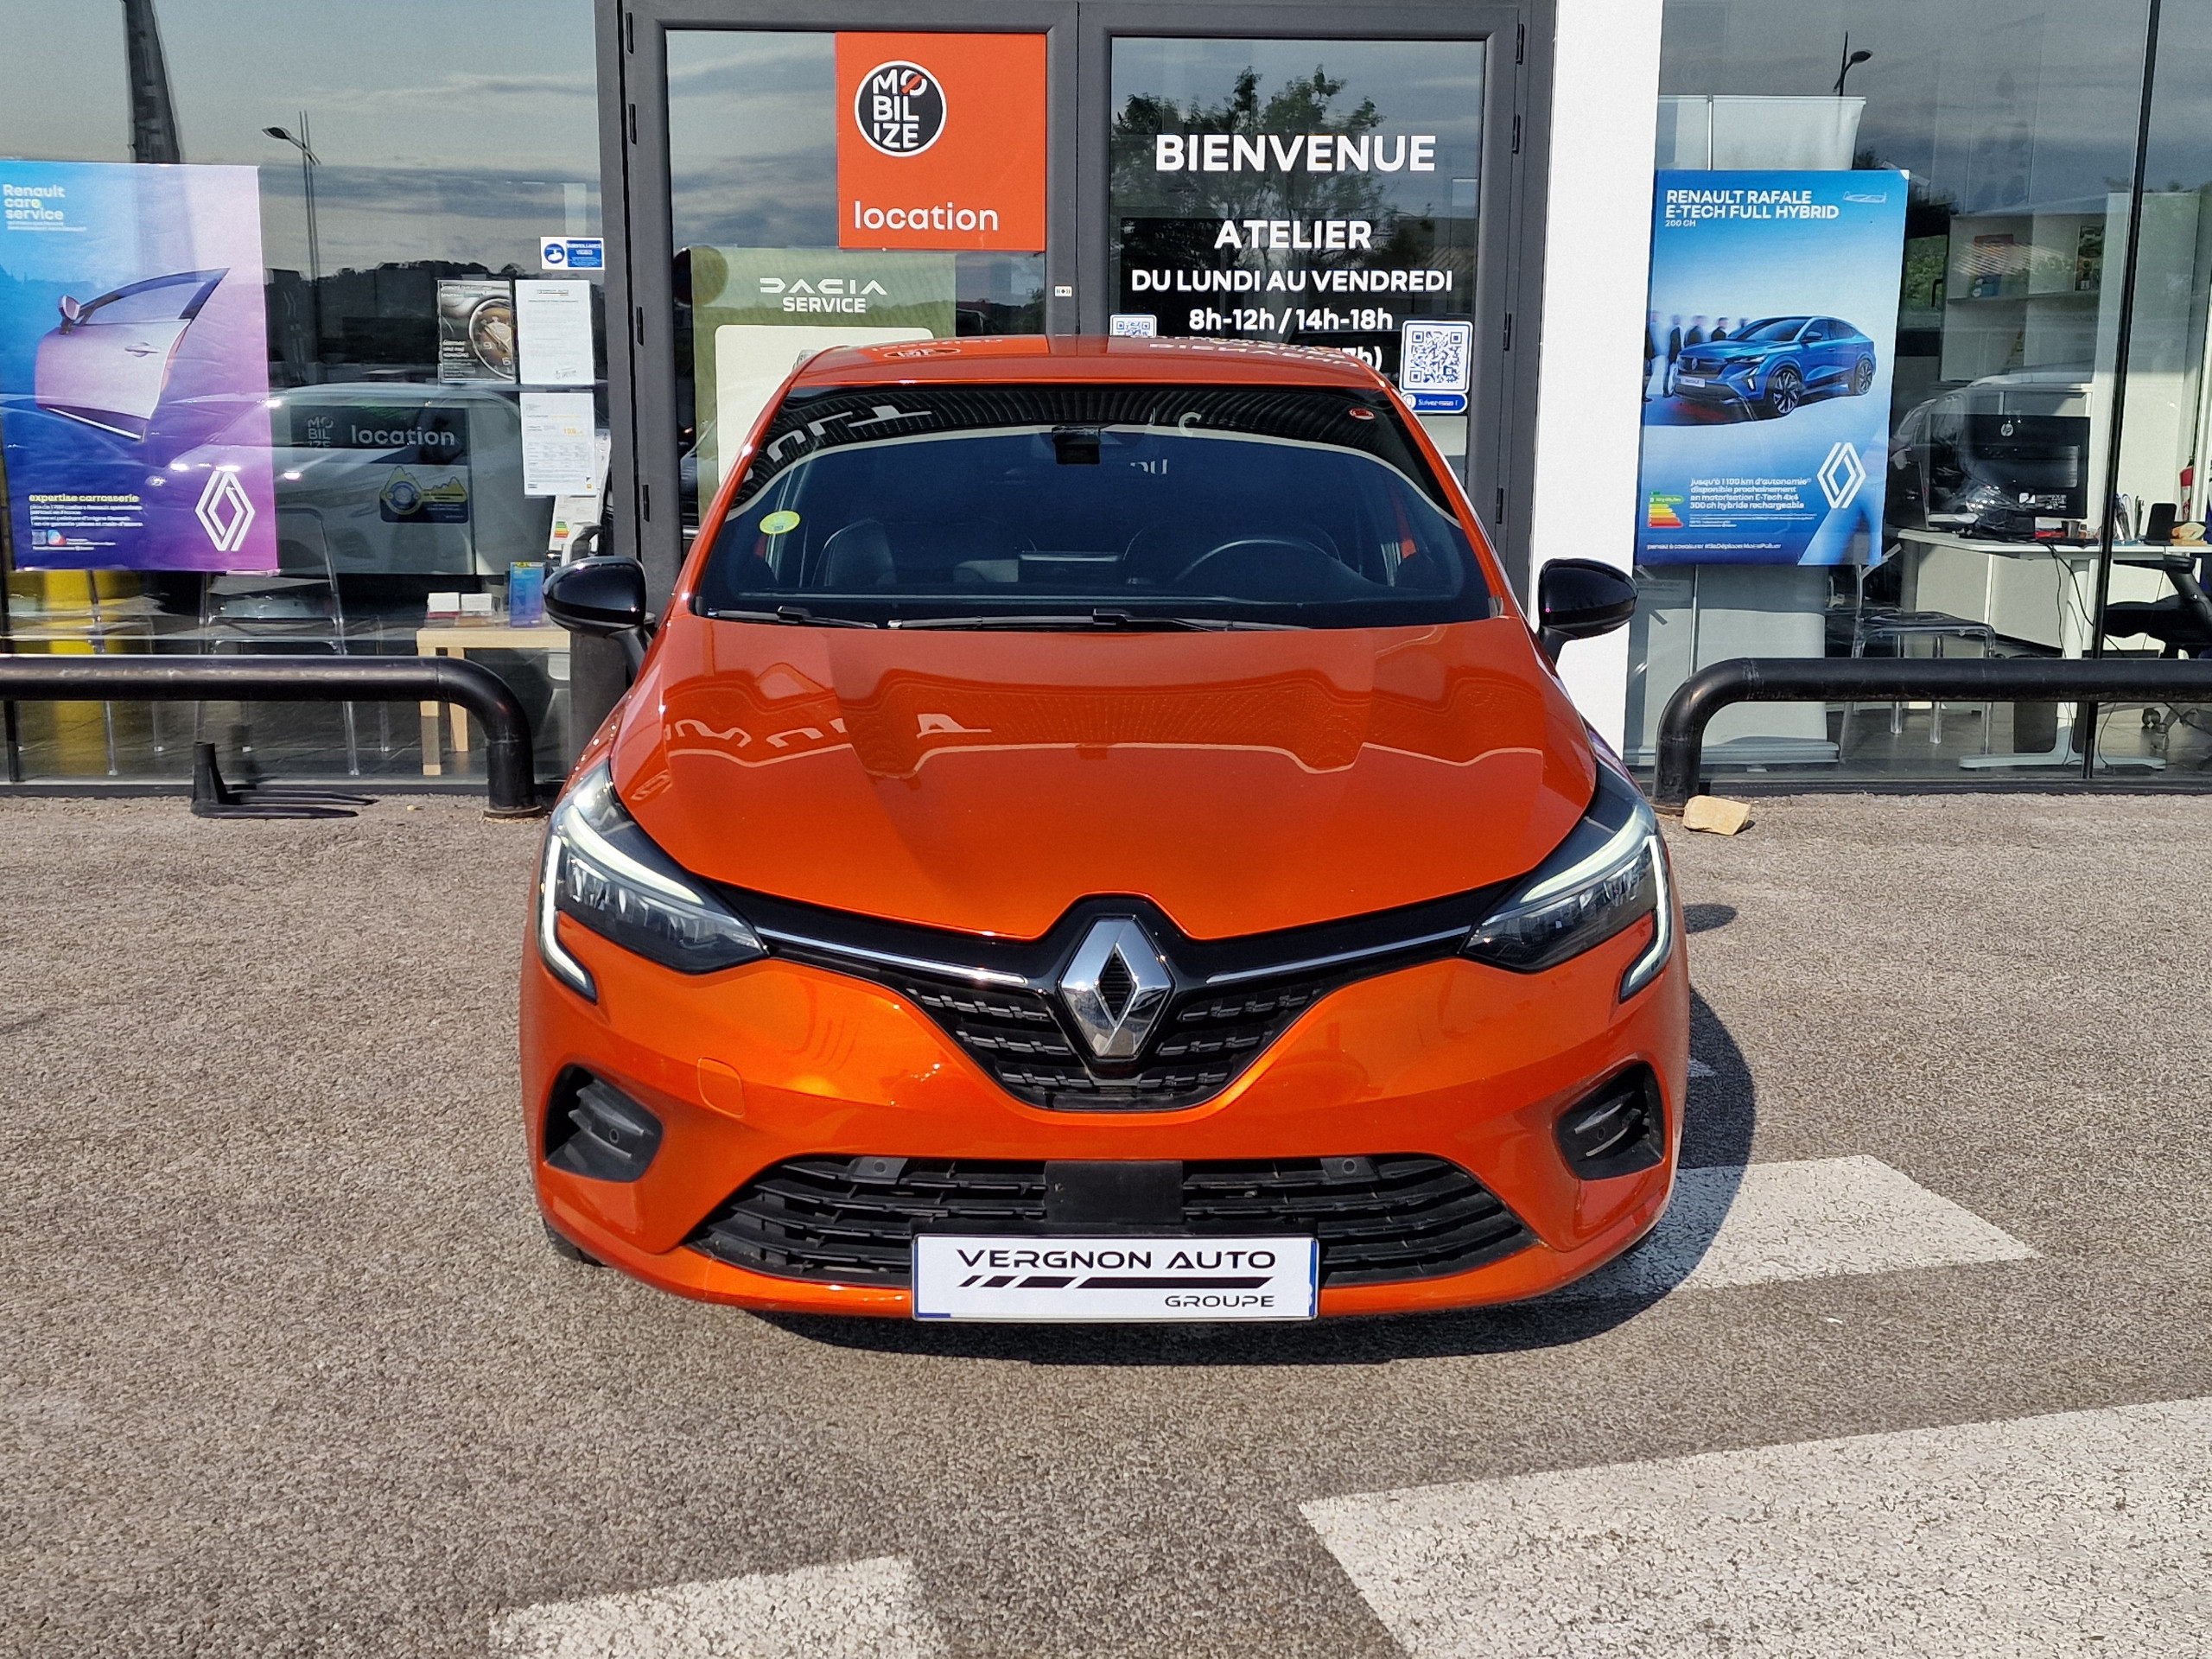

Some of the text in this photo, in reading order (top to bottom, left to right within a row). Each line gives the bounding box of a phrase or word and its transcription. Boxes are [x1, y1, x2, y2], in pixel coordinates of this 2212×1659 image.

[873, 69, 927, 97] MO
[873, 95, 919, 122] BIL
[874, 123, 919, 149] IZE
[1155, 134, 1437, 172] BIENVENUE
[3, 183, 66, 198] Renault
[1666, 189, 1812, 204] RENAULT RAFALE
[5, 207, 64, 220] service
[855, 200, 999, 231] location
[1665, 205, 1840, 219] E-TECH FULL HYBRID
[1214, 219, 1372, 251] ATELIER
[760, 277, 887, 295] DACIA
[1131, 269, 1452, 292] DU LUNDI AU VENDREDI
[782, 297, 867, 314] SERVICE
[1189, 308, 1275, 330] 8h-12h
[1294, 308, 1393, 331] 14h-18h
[308, 428, 331, 440] BIL
[351, 425, 455, 446] location
[29, 493, 140, 504] expertise carrosserie
[1690, 486, 1796, 494] disponible prochainement
[1717, 501, 1749, 510] hybride
[1749, 501, 1805, 511] rechargeable
[957, 1249, 1276, 1270] VERGNON AUTO
[1165, 1294, 1274, 1308] GROUPE
